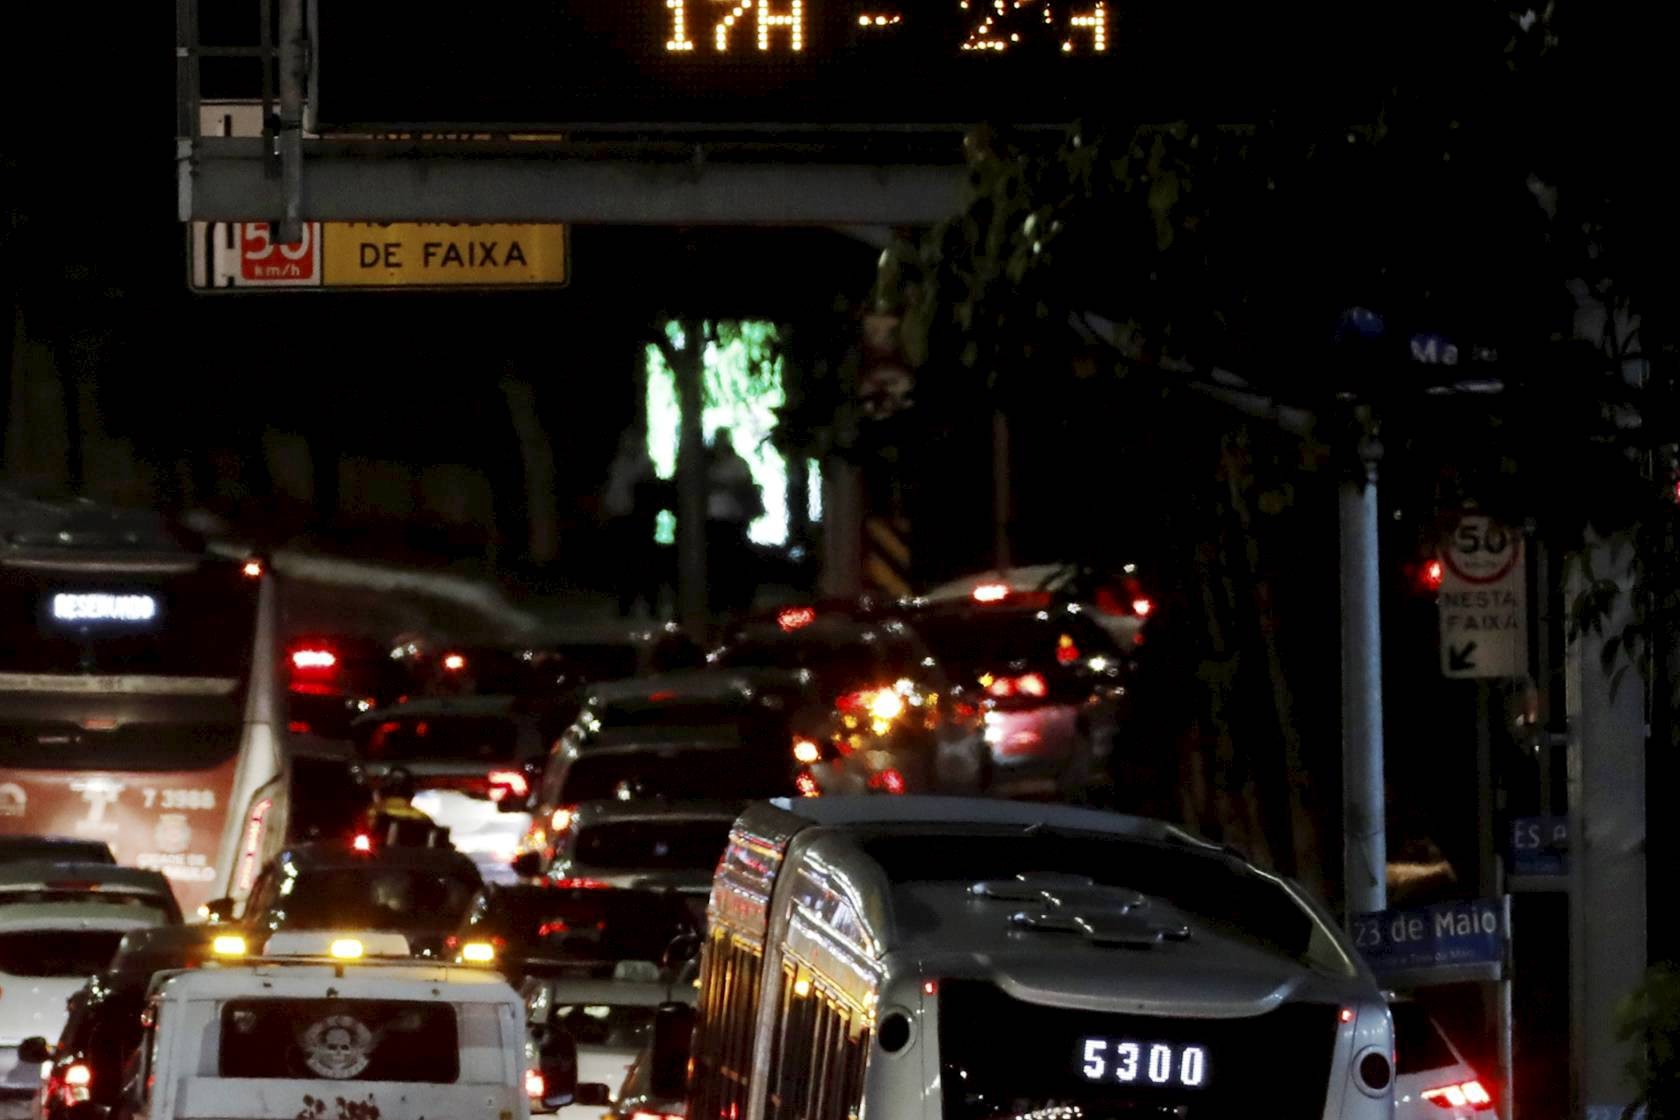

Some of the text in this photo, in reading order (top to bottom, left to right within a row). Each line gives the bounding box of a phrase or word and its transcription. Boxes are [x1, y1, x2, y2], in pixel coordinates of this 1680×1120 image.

[359, 241, 528, 268] DE FAIXA
[254, 263, 300, 277] km/h
[1456, 525, 1507, 553] 50
[1446, 615, 1519, 630] FAIXA
[1354, 906, 1497, 946] 23 de Maio
[1082, 1039, 1204, 1087] 5300
